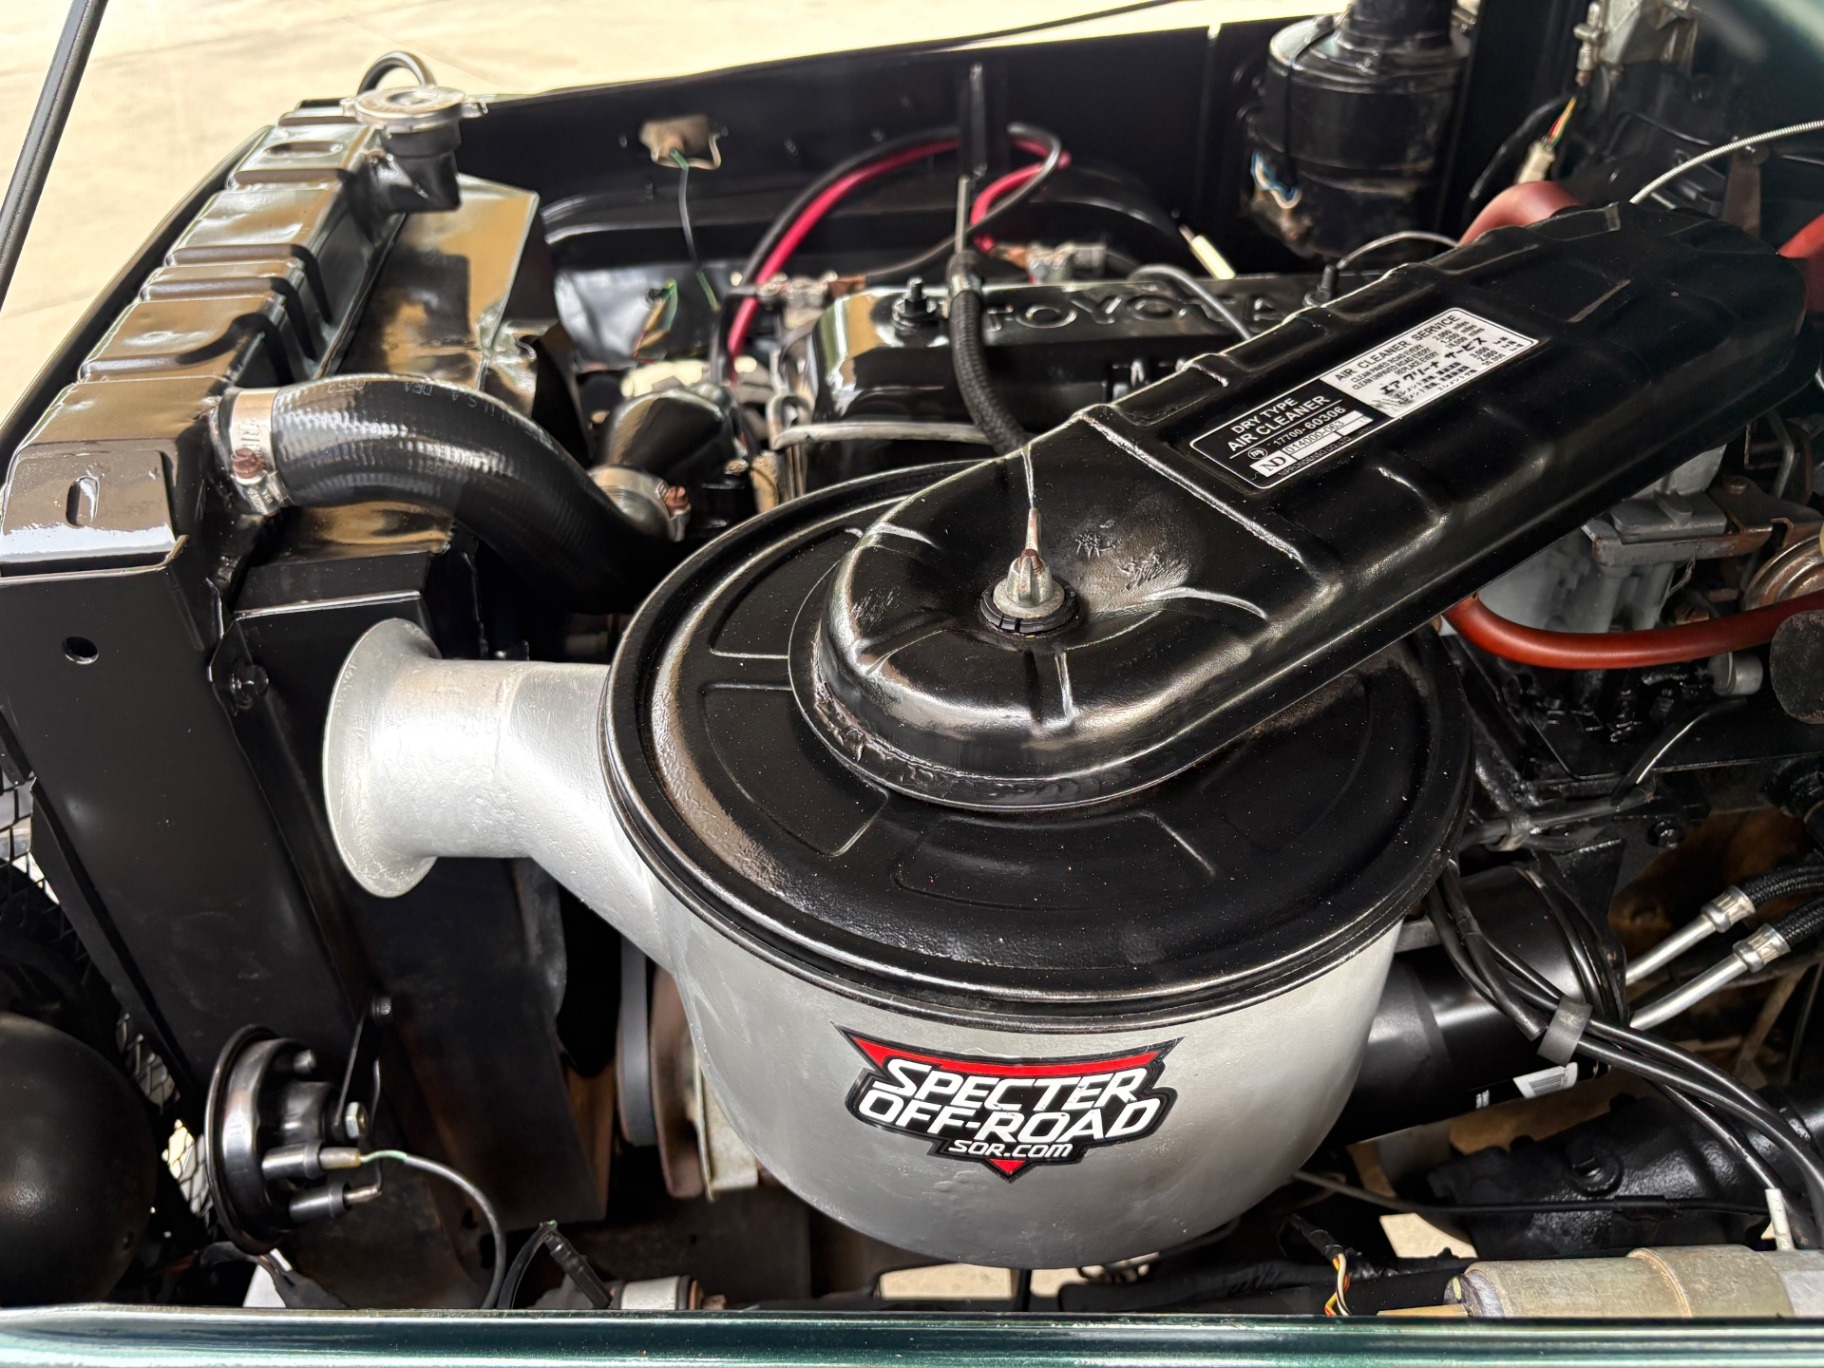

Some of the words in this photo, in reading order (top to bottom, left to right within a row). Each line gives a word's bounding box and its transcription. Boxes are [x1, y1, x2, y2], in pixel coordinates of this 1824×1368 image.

[1332, 367, 1358, 381] AIR
[1355, 340, 1412, 369] CLEANER
[1409, 314, 1461, 341] SERVICE
[1349, 370, 1373, 382] CLEAN
[1386, 353, 1406, 363] ROAD
[1402, 343, 1425, 355] EVERY
[1350, 377, 1374, 390] CLEAN
[1394, 356, 1415, 367] ROAD
[1410, 347, 1433, 358] EVERY
[1393, 360, 1422, 375] REPLACE
[1417, 350, 1440, 362] EVERY
[1223, 432, 1259, 451] AIR
[1253, 394, 1331, 436] CLEANER
[1230, 415, 1264, 433] DRY
[1258, 397, 1299, 419] TYPE
[1270, 405, 1347, 446] 17700-60306
[1259, 455, 1289, 471] ND
[873, 1058, 1148, 1112] SPECTER
[858, 1089, 1161, 1144] OFF-ROAD
